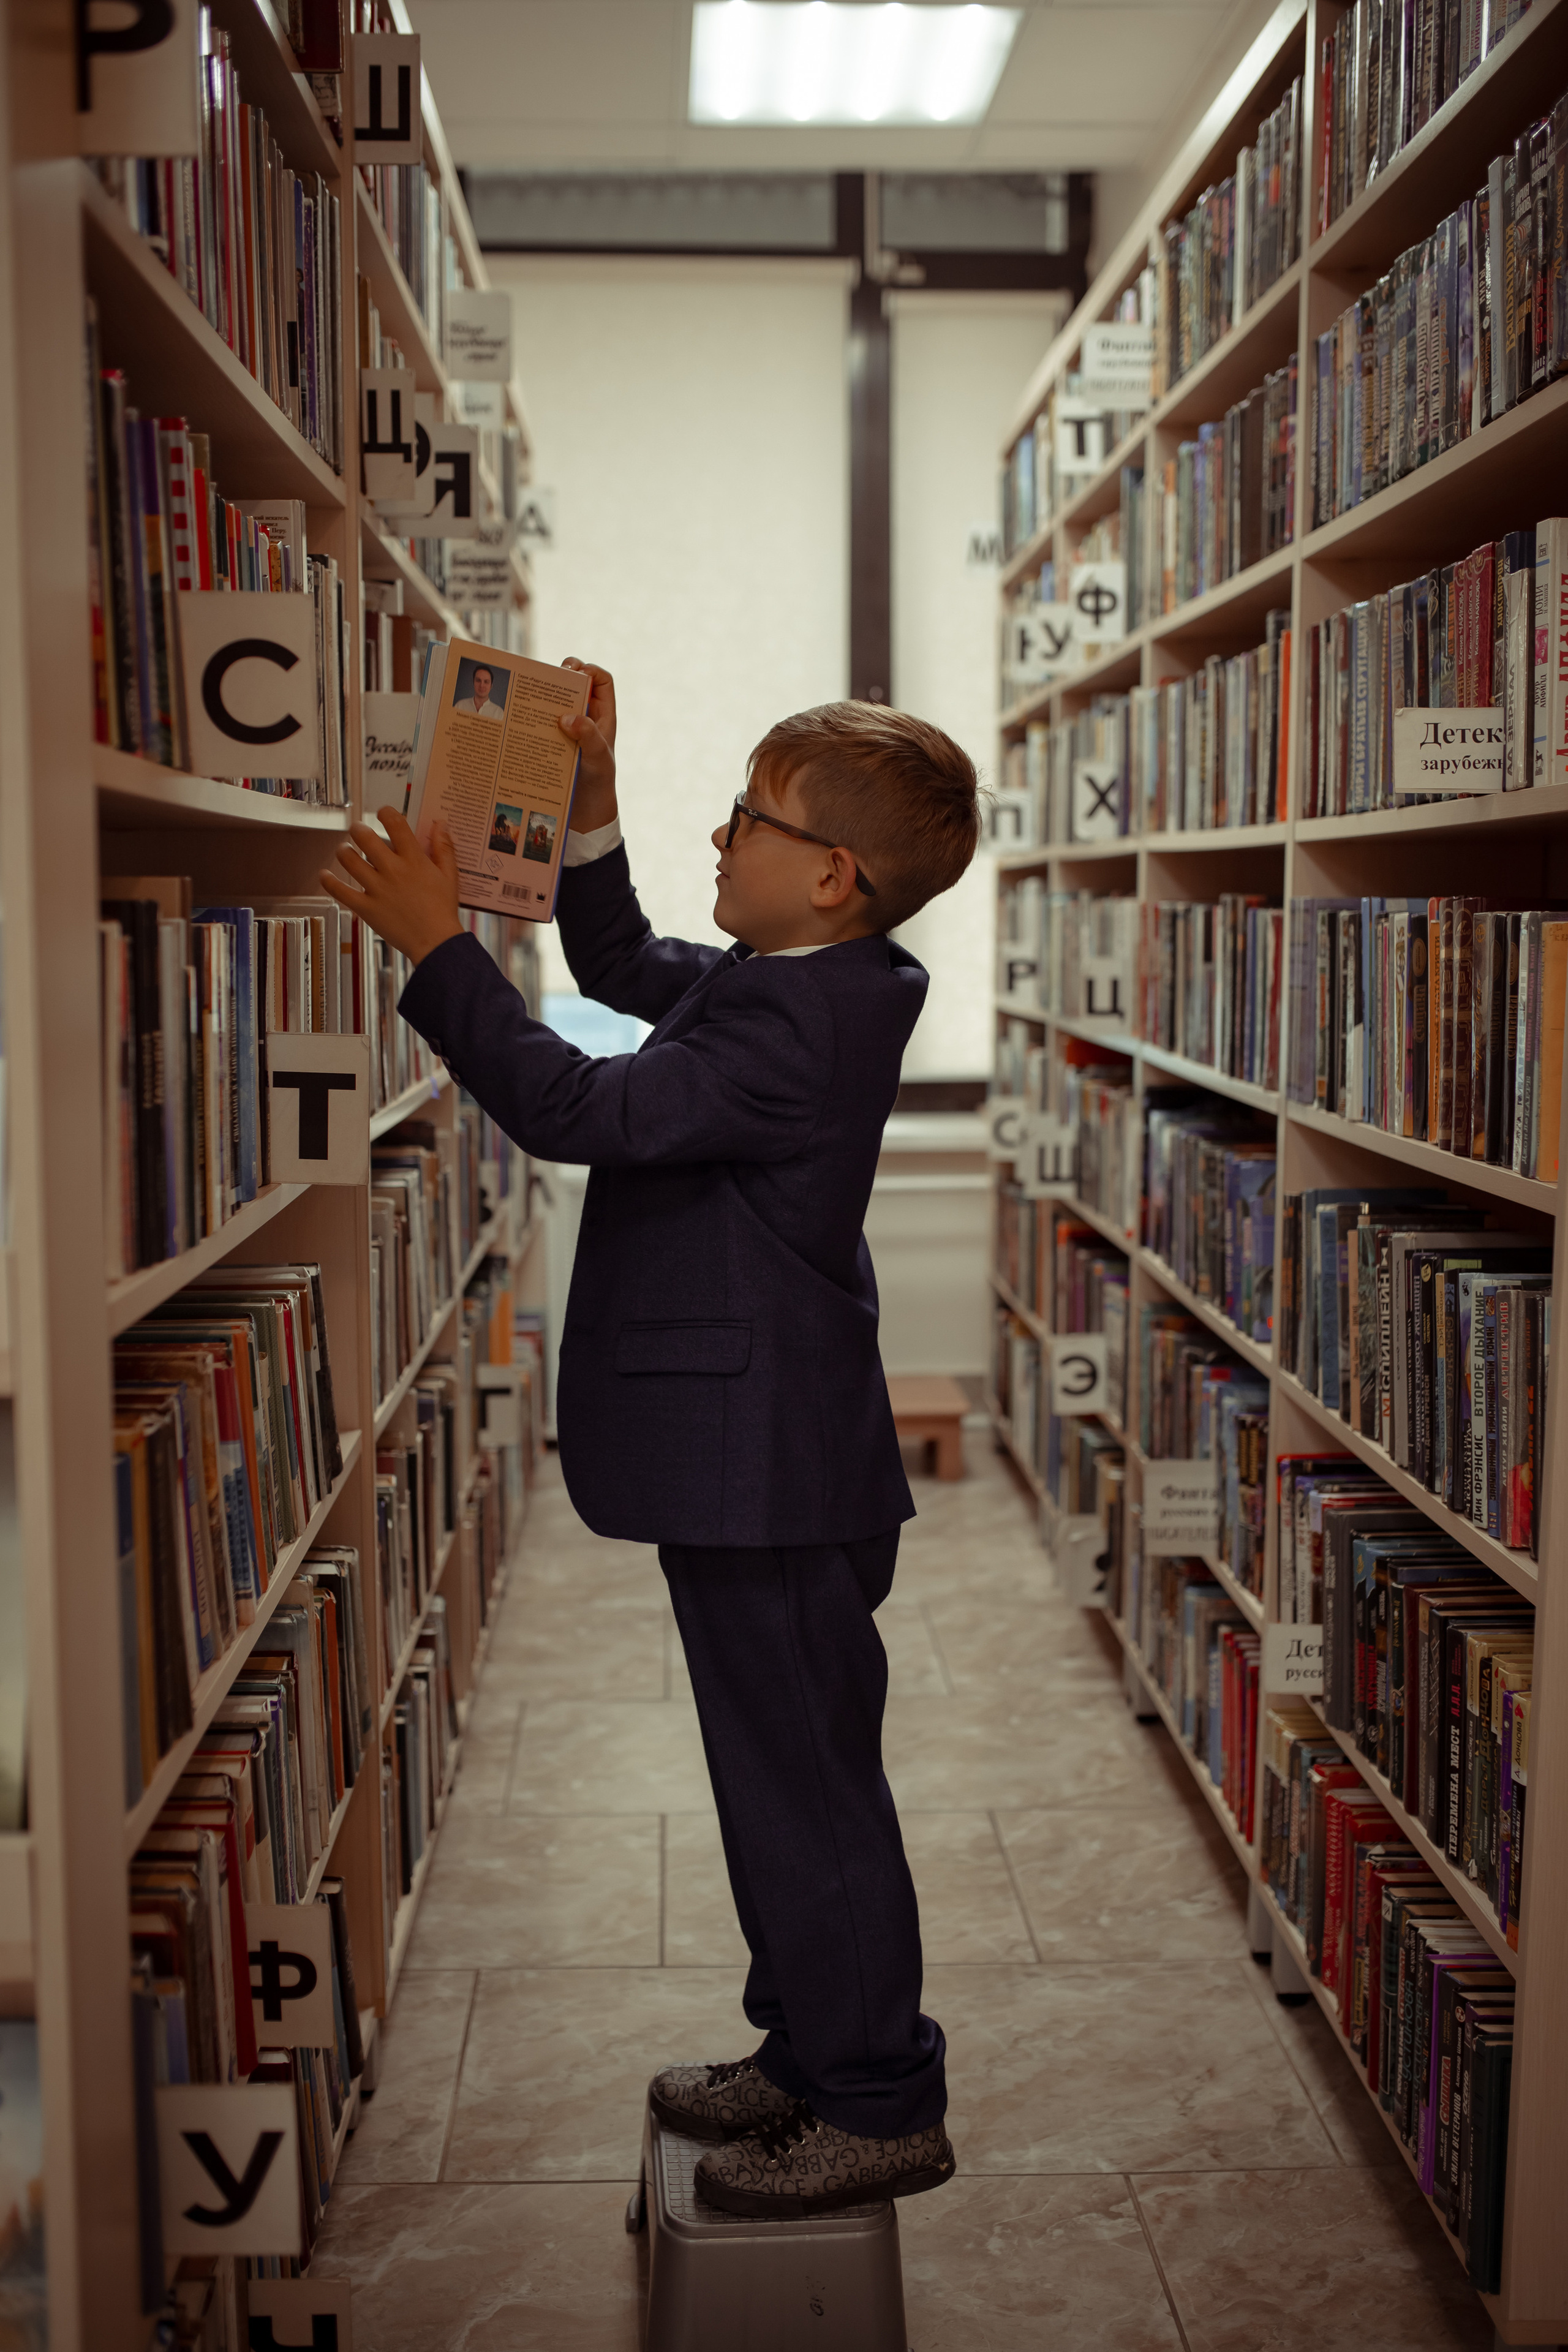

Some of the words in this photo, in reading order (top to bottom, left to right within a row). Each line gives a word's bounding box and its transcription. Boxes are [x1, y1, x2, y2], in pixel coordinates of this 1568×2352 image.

[363, 390, 412, 463] Ц
[1062, 417, 1103, 456] Т
[435, 452, 470, 518] Я
[1078, 586, 1117, 625] Ф
[1042, 621, 1071, 659] У
[1357, 606, 1368, 698] СТРУГАЦКИХ
[202, 638, 302, 744] С
[1355, 699, 1367, 761] БРАТЬЕВ
[1420, 722, 1502, 750] Детек
[1084, 774, 1120, 818] Х
[1008, 961, 1038, 990] Р
[1087, 978, 1124, 1019] Ц
[273, 1072, 356, 1160] Т
[1378, 1273, 1390, 1392] СПИЛЛЕЙН
[1474, 1291, 1485, 1358] ДЫХАНИЕ
[1485, 1326, 1494, 1357] РОМАН
[1500, 1301, 1509, 1400] ДЕТЕКТИВ
[1061, 1354, 1097, 1395] Э
[1474, 1363, 1483, 1417] ВТОРОЕ
[1474, 1434, 1483, 1494] ФРЭНСИС
[1474, 1498, 1483, 1523] Дик
[1450, 1725, 1460, 1769] МЕСТ
[1513, 1722, 1523, 1766] Донцова
[1448, 1773, 1459, 1857] ПЕРЕМЕНА
[248, 1940, 317, 2020] Ф
[1402, 1980, 1414, 2081] УСТИНОВА
[1413, 1992, 1423, 2091] УСТИНОВА
[1451, 2092, 1461, 2149] ВЕТЕРАНОВ
[181, 2132, 285, 2227] У
[1450, 2149, 1459, 2186] ЗЕМЛЯ
